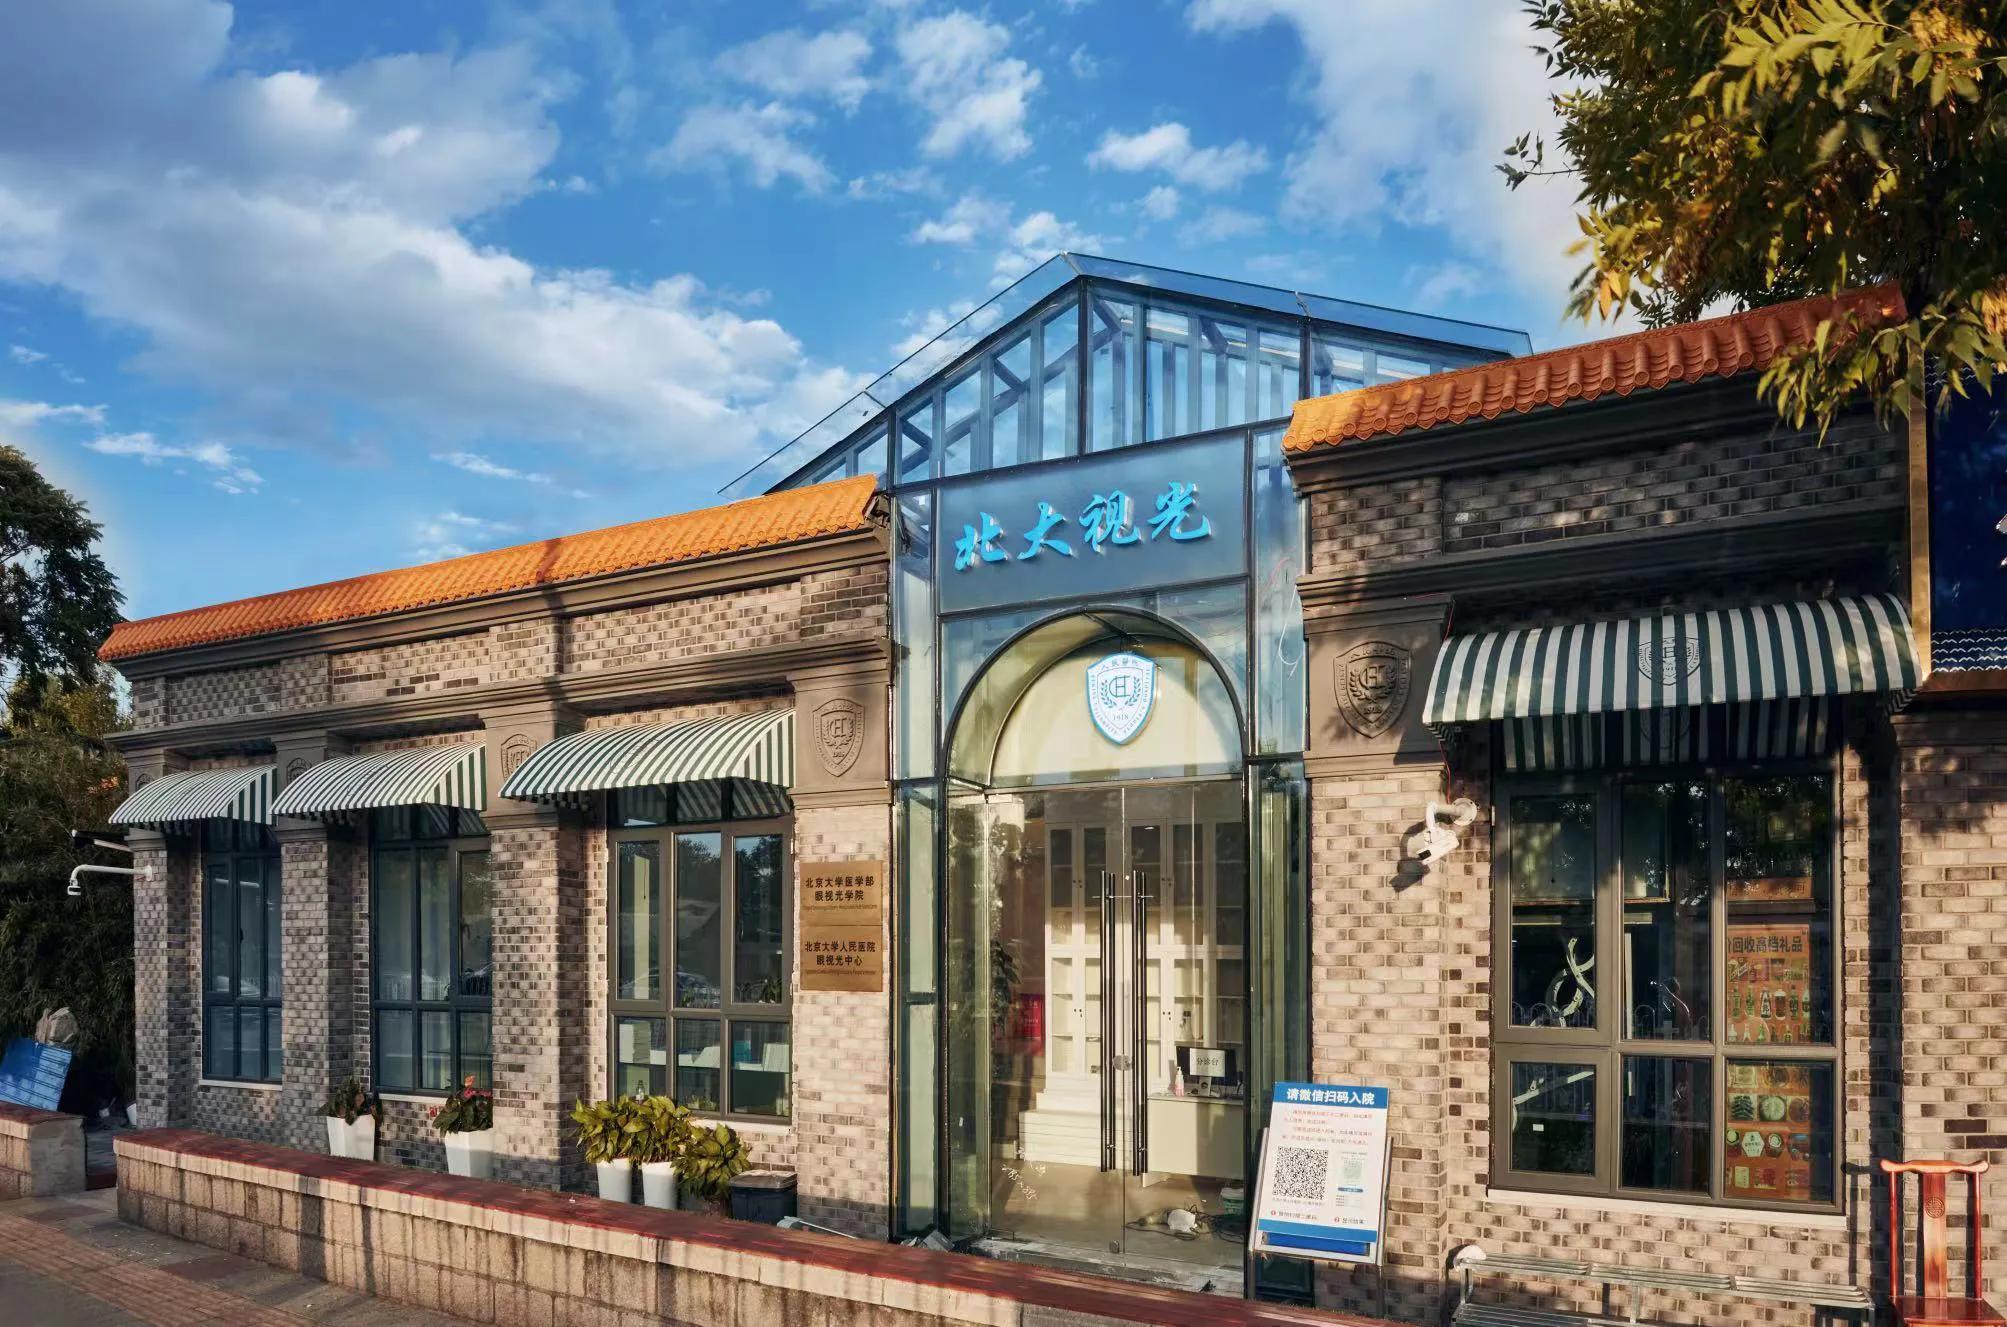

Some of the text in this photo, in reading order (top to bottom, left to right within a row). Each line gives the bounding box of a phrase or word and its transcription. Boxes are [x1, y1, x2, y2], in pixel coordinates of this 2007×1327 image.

[953, 481, 1212, 572] 北大视光
[805, 875, 875, 888] 北京大学医学部
[814, 890, 864, 902] 眼视光学院
[805, 940, 876, 953] 北京大学人民医院
[816, 954, 863, 966] 眼视光中心
[1286, 1088, 1375, 1105] 请微信扫码入院
